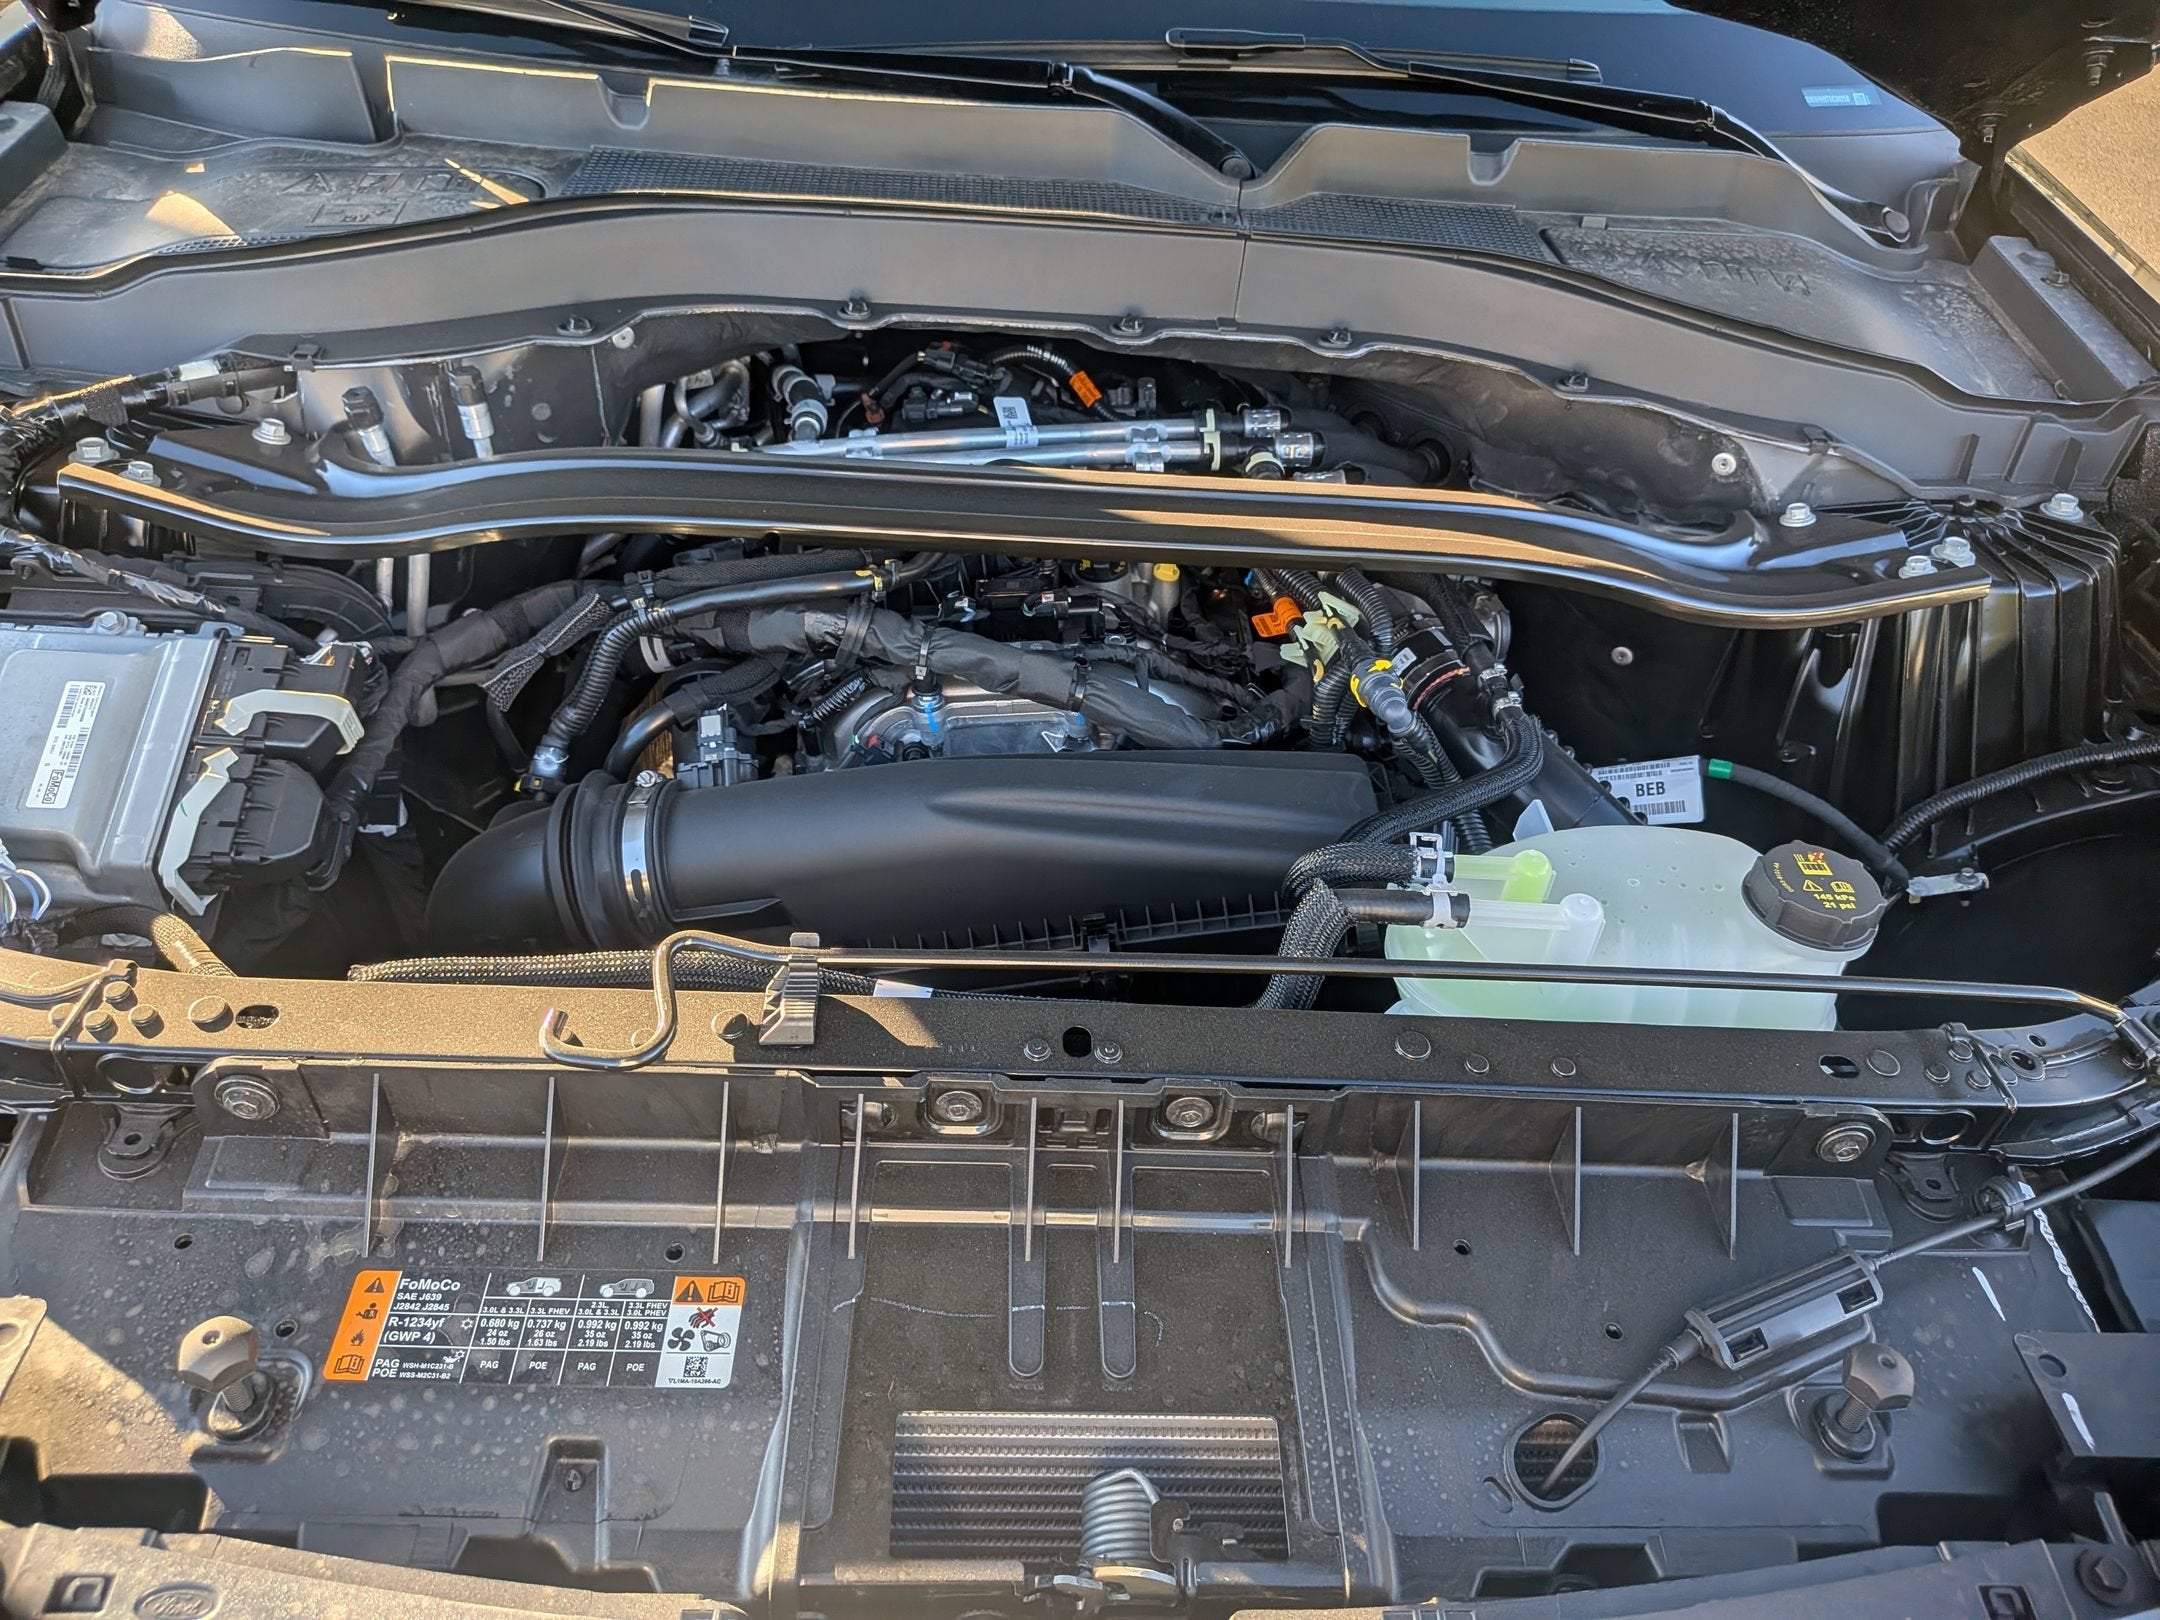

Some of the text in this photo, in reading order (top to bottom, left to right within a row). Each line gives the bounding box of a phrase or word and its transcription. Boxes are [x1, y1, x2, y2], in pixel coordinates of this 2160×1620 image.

[44, 772, 62, 802] FoMoCo
[1636, 782, 1665, 797] BEB
[400, 1278, 460, 1291] FoMoCo
[396, 1292, 418, 1300] SAE
[388, 1316, 446, 1330] R-1234yf
[480, 1318, 520, 1330] 0.680 kg
[527, 1320, 566, 1330] 0.737 kg
[578, 1320, 617, 1331] 0.992 kg
[624, 1322, 664, 1332] 0.992 kg
[384, 1330, 436, 1344] (GWP 4)
[480, 1338, 498, 1346] 1.50
[528, 1338, 544, 1346] 1.63
[374, 1358, 400, 1368] PAG
[480, 1361, 500, 1369] PAG
[529, 1362, 548, 1370] POE
[626, 1363, 645, 1371] POE
[372, 1368, 397, 1378] POE
